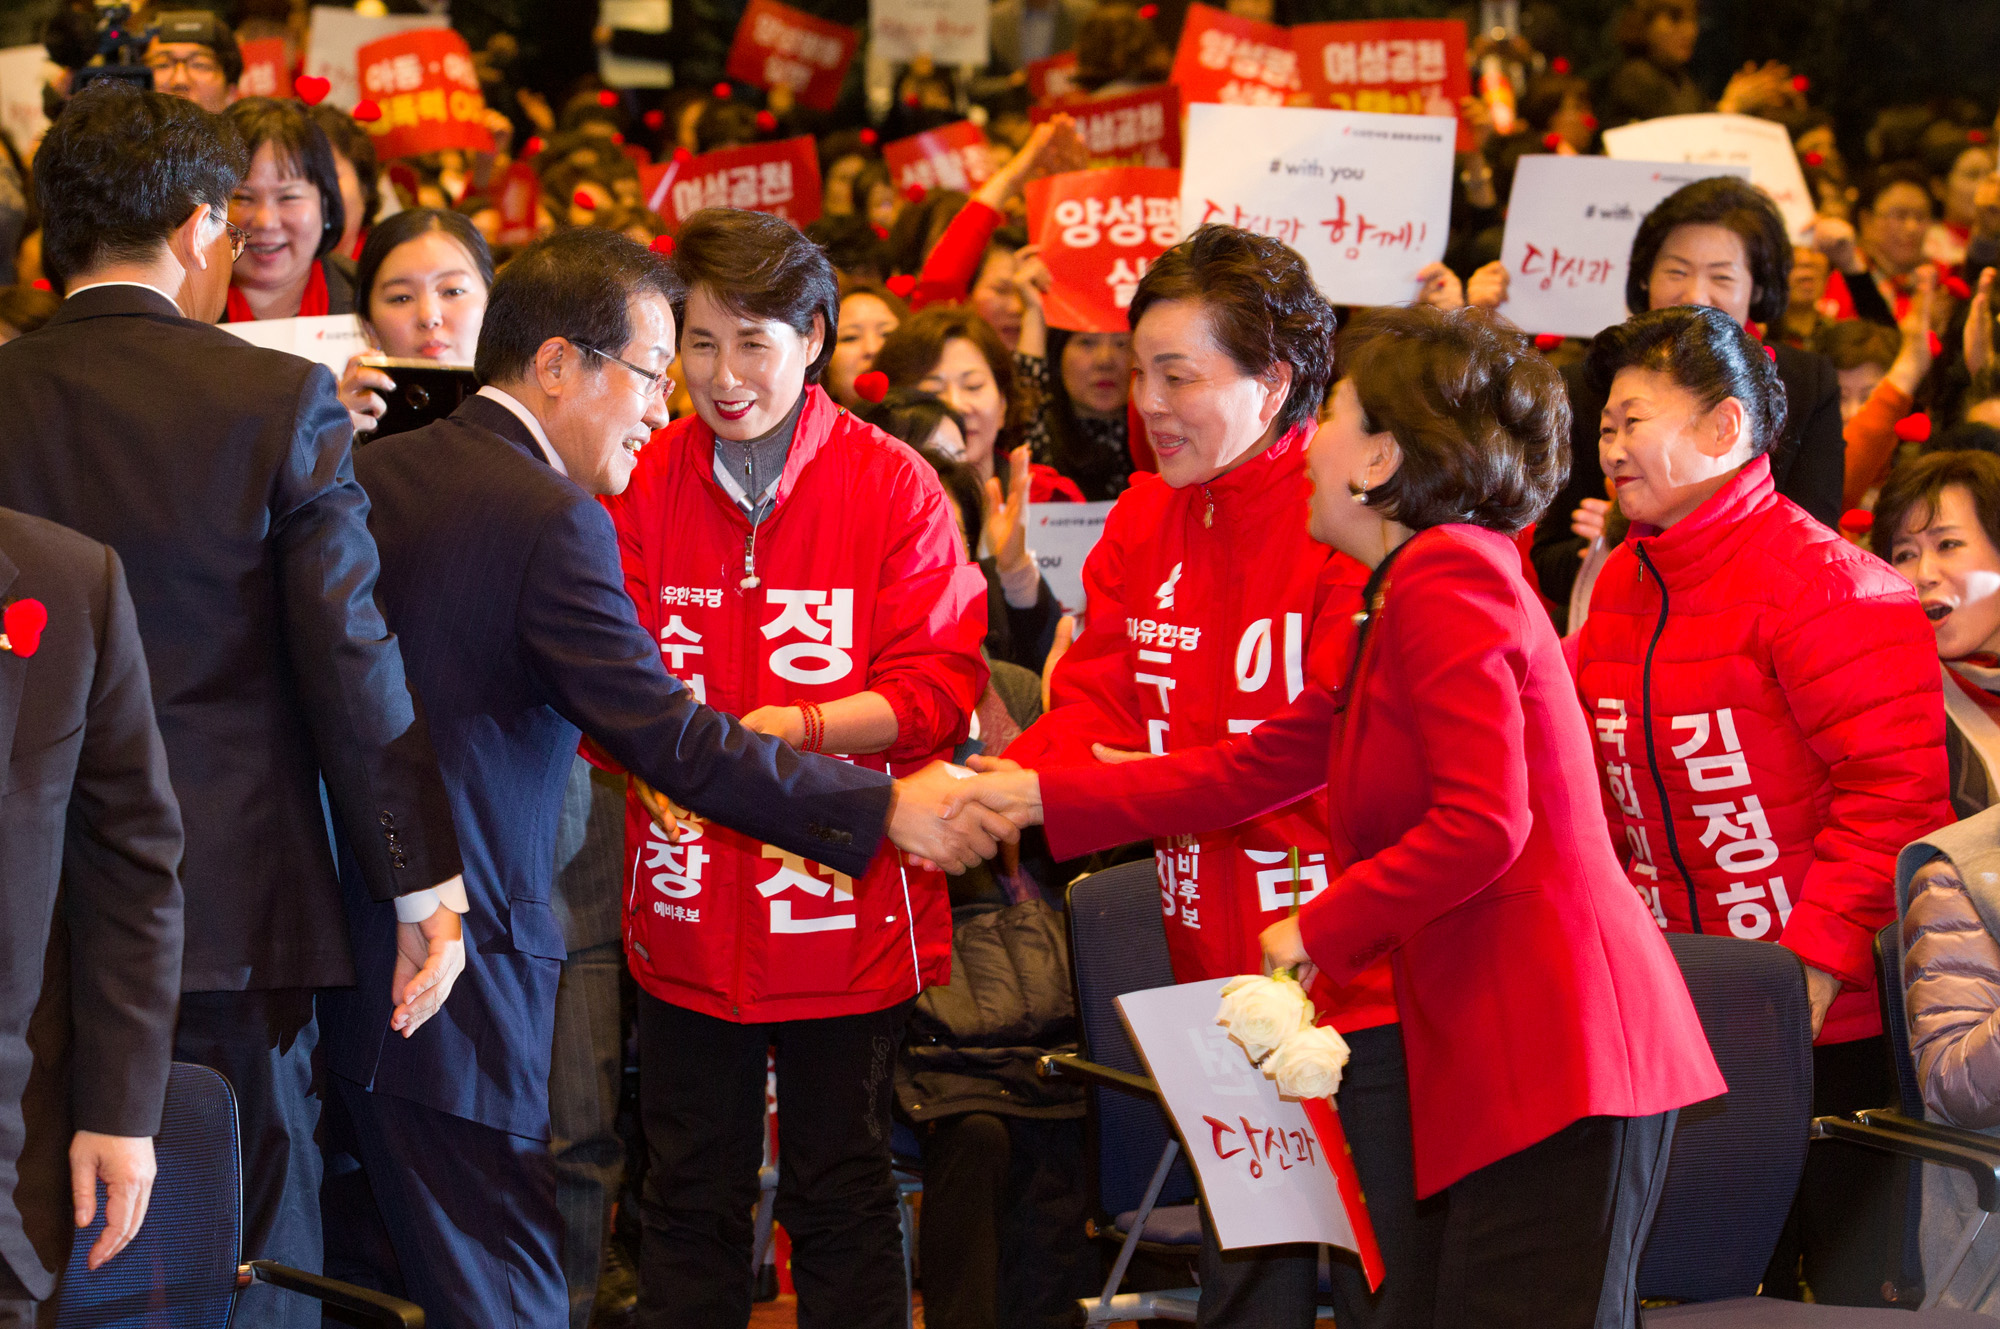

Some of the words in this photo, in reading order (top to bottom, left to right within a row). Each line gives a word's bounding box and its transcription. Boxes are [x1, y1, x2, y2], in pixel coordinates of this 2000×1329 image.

[1323, 39, 1447, 84] 여성공천
[1331, 164, 1365, 182] you
[1320, 195, 1427, 260] 함께!
[1520, 243, 1615, 290] 당신과
[653, 901, 701, 923] 예비후보
[1202, 1114, 1316, 1178] 당신과
